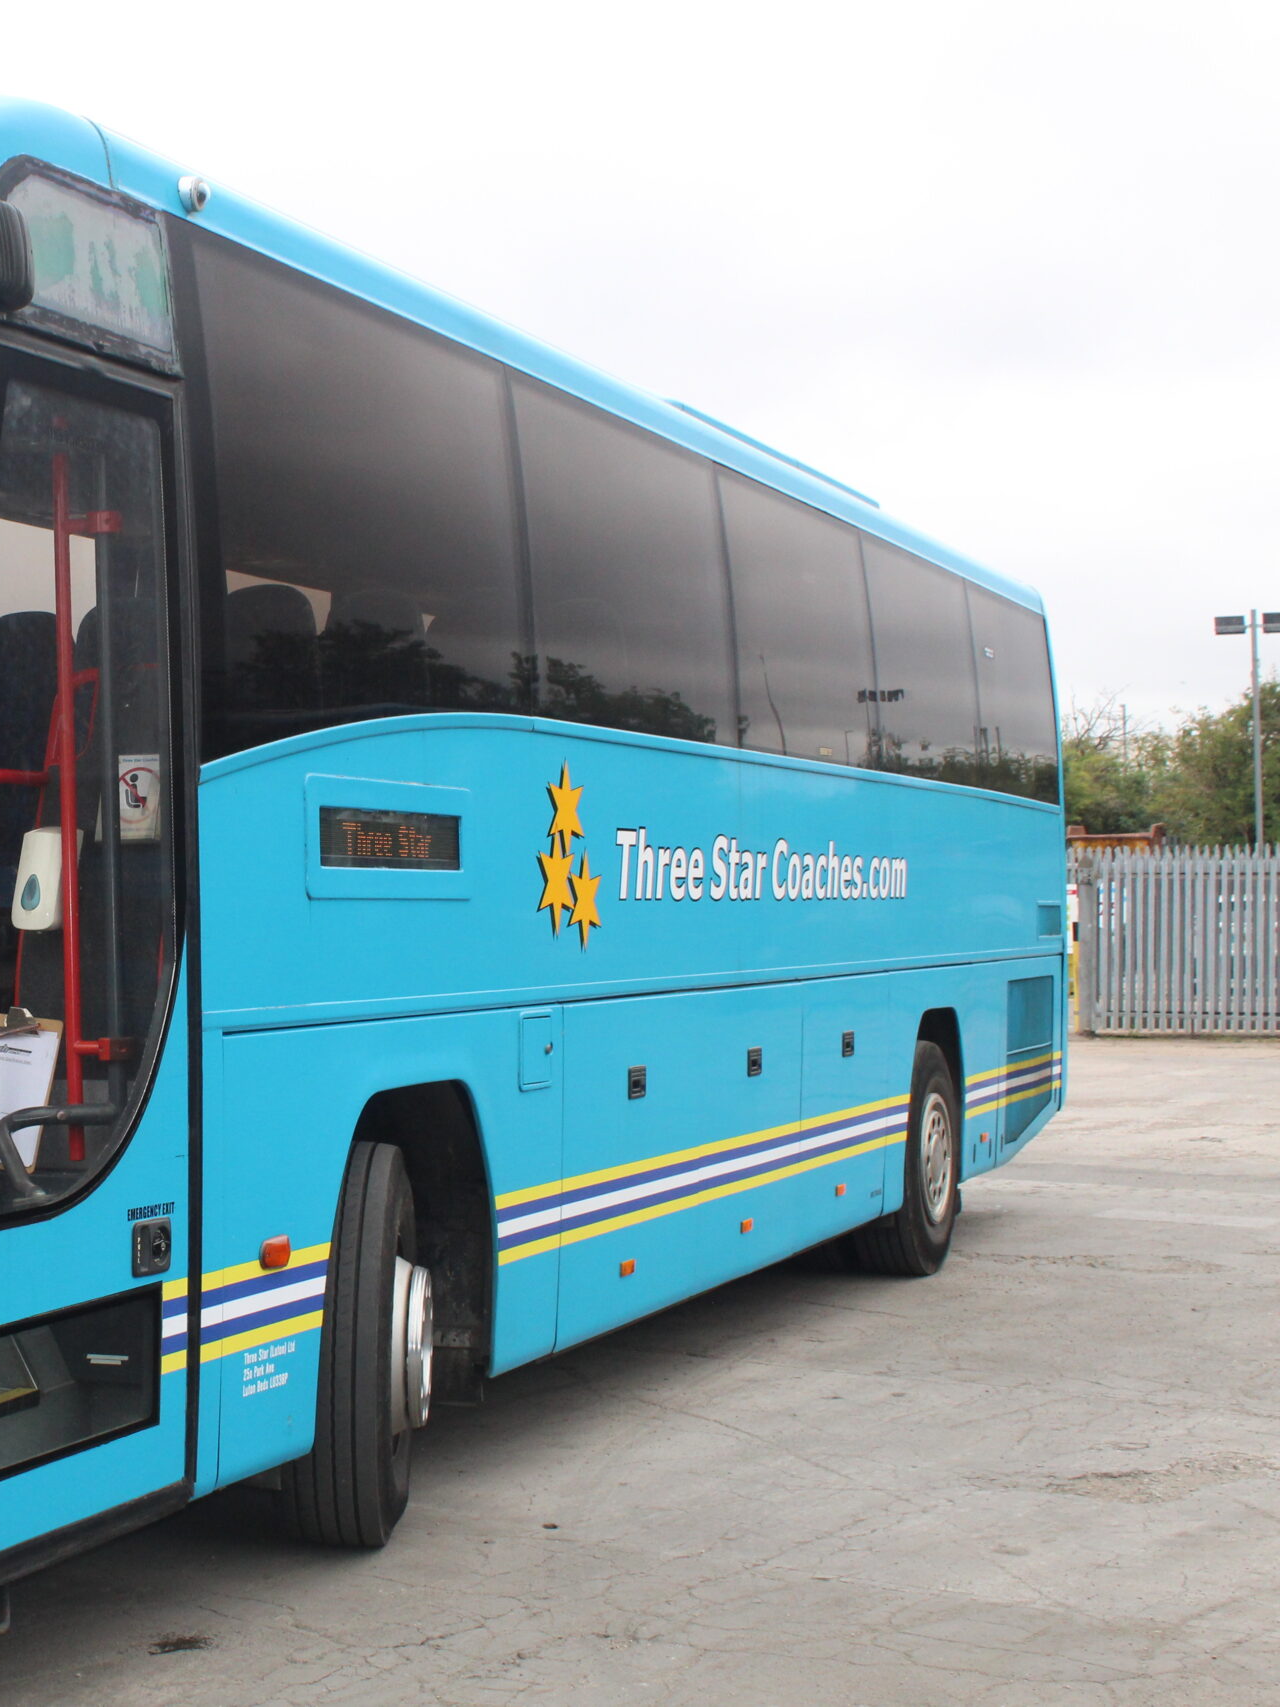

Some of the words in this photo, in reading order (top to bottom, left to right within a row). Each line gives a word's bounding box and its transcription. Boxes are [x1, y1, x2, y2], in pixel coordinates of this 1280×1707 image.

[342, 822, 393, 856] Three
[616, 826, 704, 901] Three
[709, 834, 767, 901] Star
[772, 837, 907, 901] Coaches.com
[127, 1204, 161, 1221] EMERGENCY
[162, 1201, 175, 1215] EXIT
[259, 1348, 269, 1361] Star
